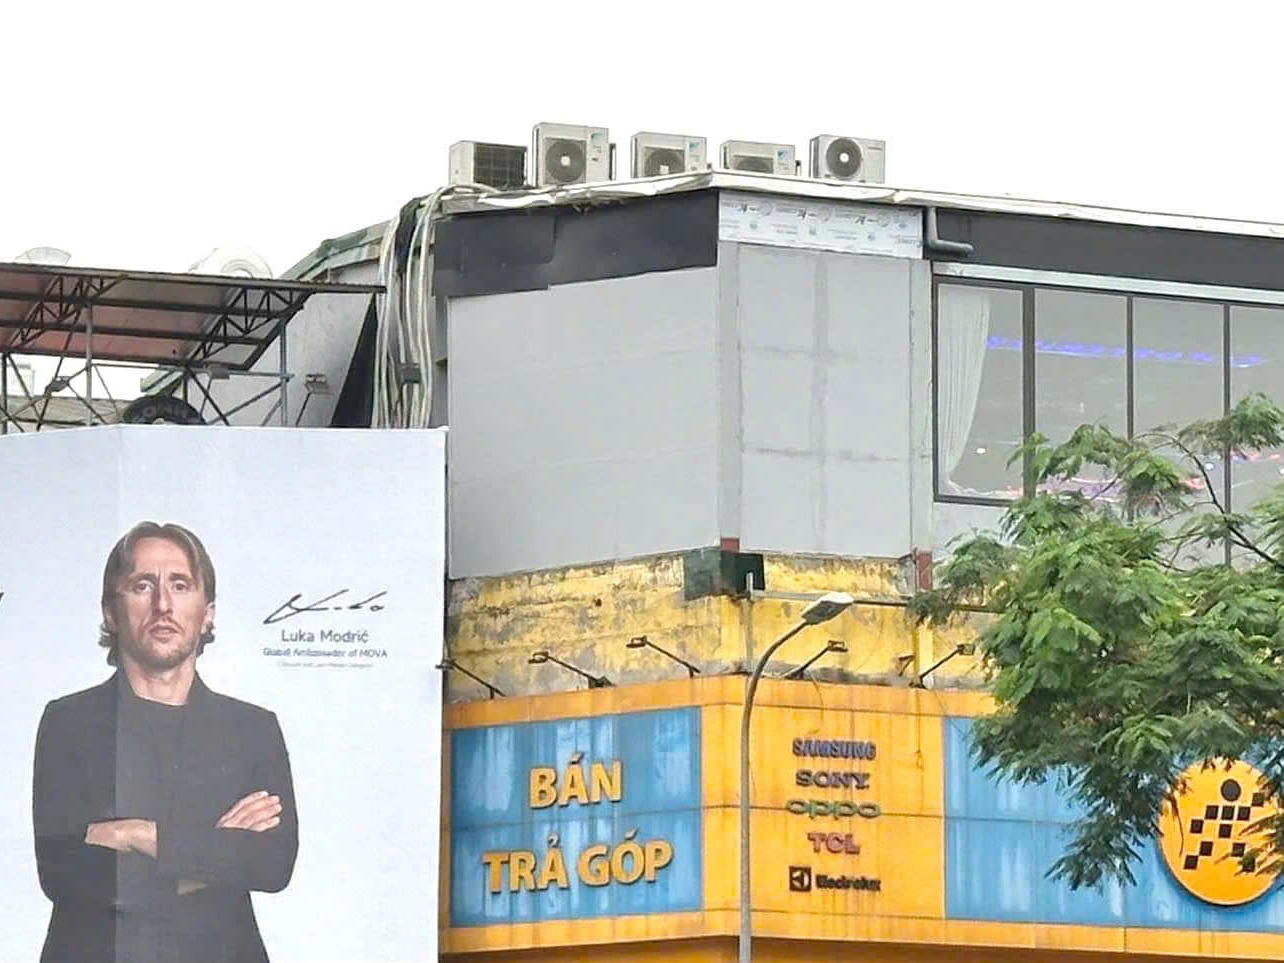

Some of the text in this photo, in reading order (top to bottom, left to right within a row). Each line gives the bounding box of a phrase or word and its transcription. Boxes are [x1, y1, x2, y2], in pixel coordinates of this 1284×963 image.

[281, 628, 369, 643] Luka Modrić
[359, 649, 388, 658] MOVA
[792, 737, 876, 761] SAMSUNG
[529, 752, 623, 809] BÁN
[795, 769, 870, 789] SONY
[807, 832, 861, 854] TCL
[482, 828, 673, 894] TRẢ GÓP
